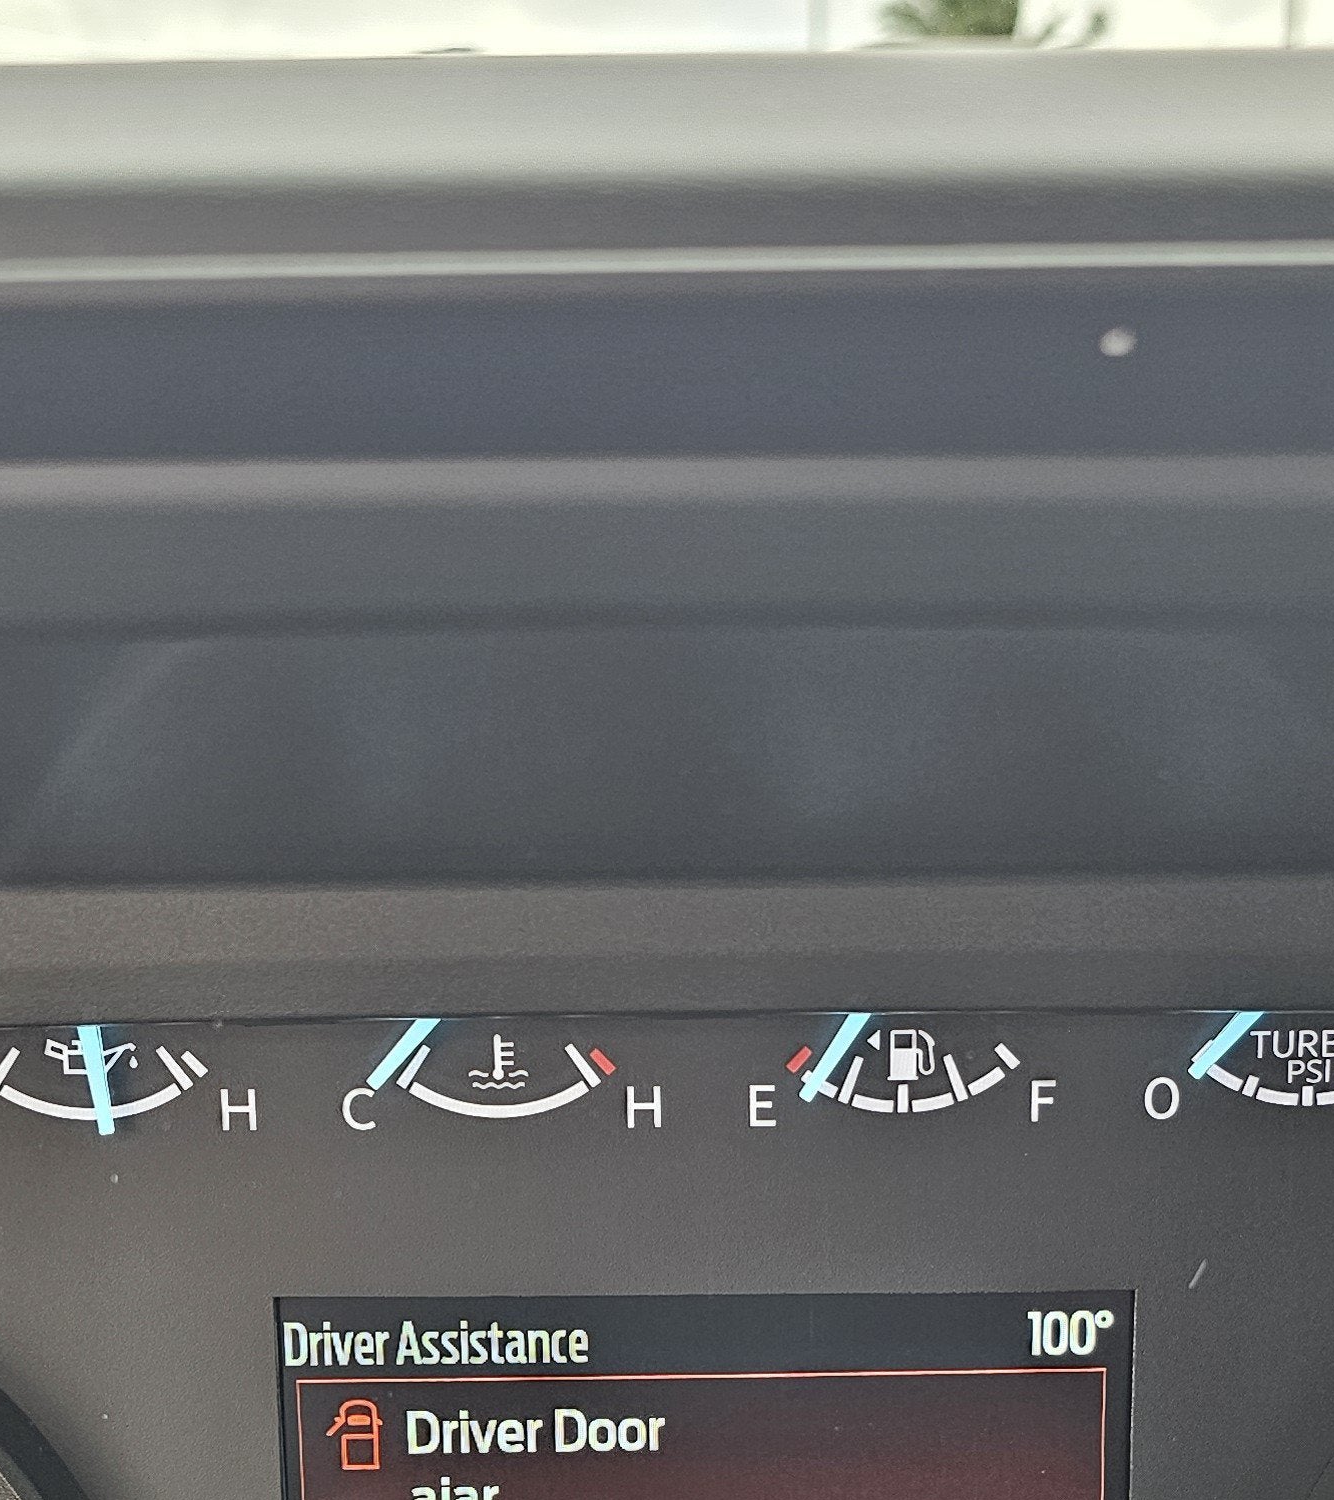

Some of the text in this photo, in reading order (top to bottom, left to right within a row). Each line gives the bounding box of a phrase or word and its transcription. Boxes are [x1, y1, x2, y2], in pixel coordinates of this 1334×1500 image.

[1287, 1059, 1331, 1084] PSI
[220, 1088, 258, 1131] H
[342, 1087, 378, 1131] C
[626, 1085, 662, 1129] H
[749, 1084, 777, 1127] E
[1030, 1079, 1057, 1123] F
[282, 1320, 589, 1367] Driver Assistance
[406, 1408, 666, 1455] Driver Door
